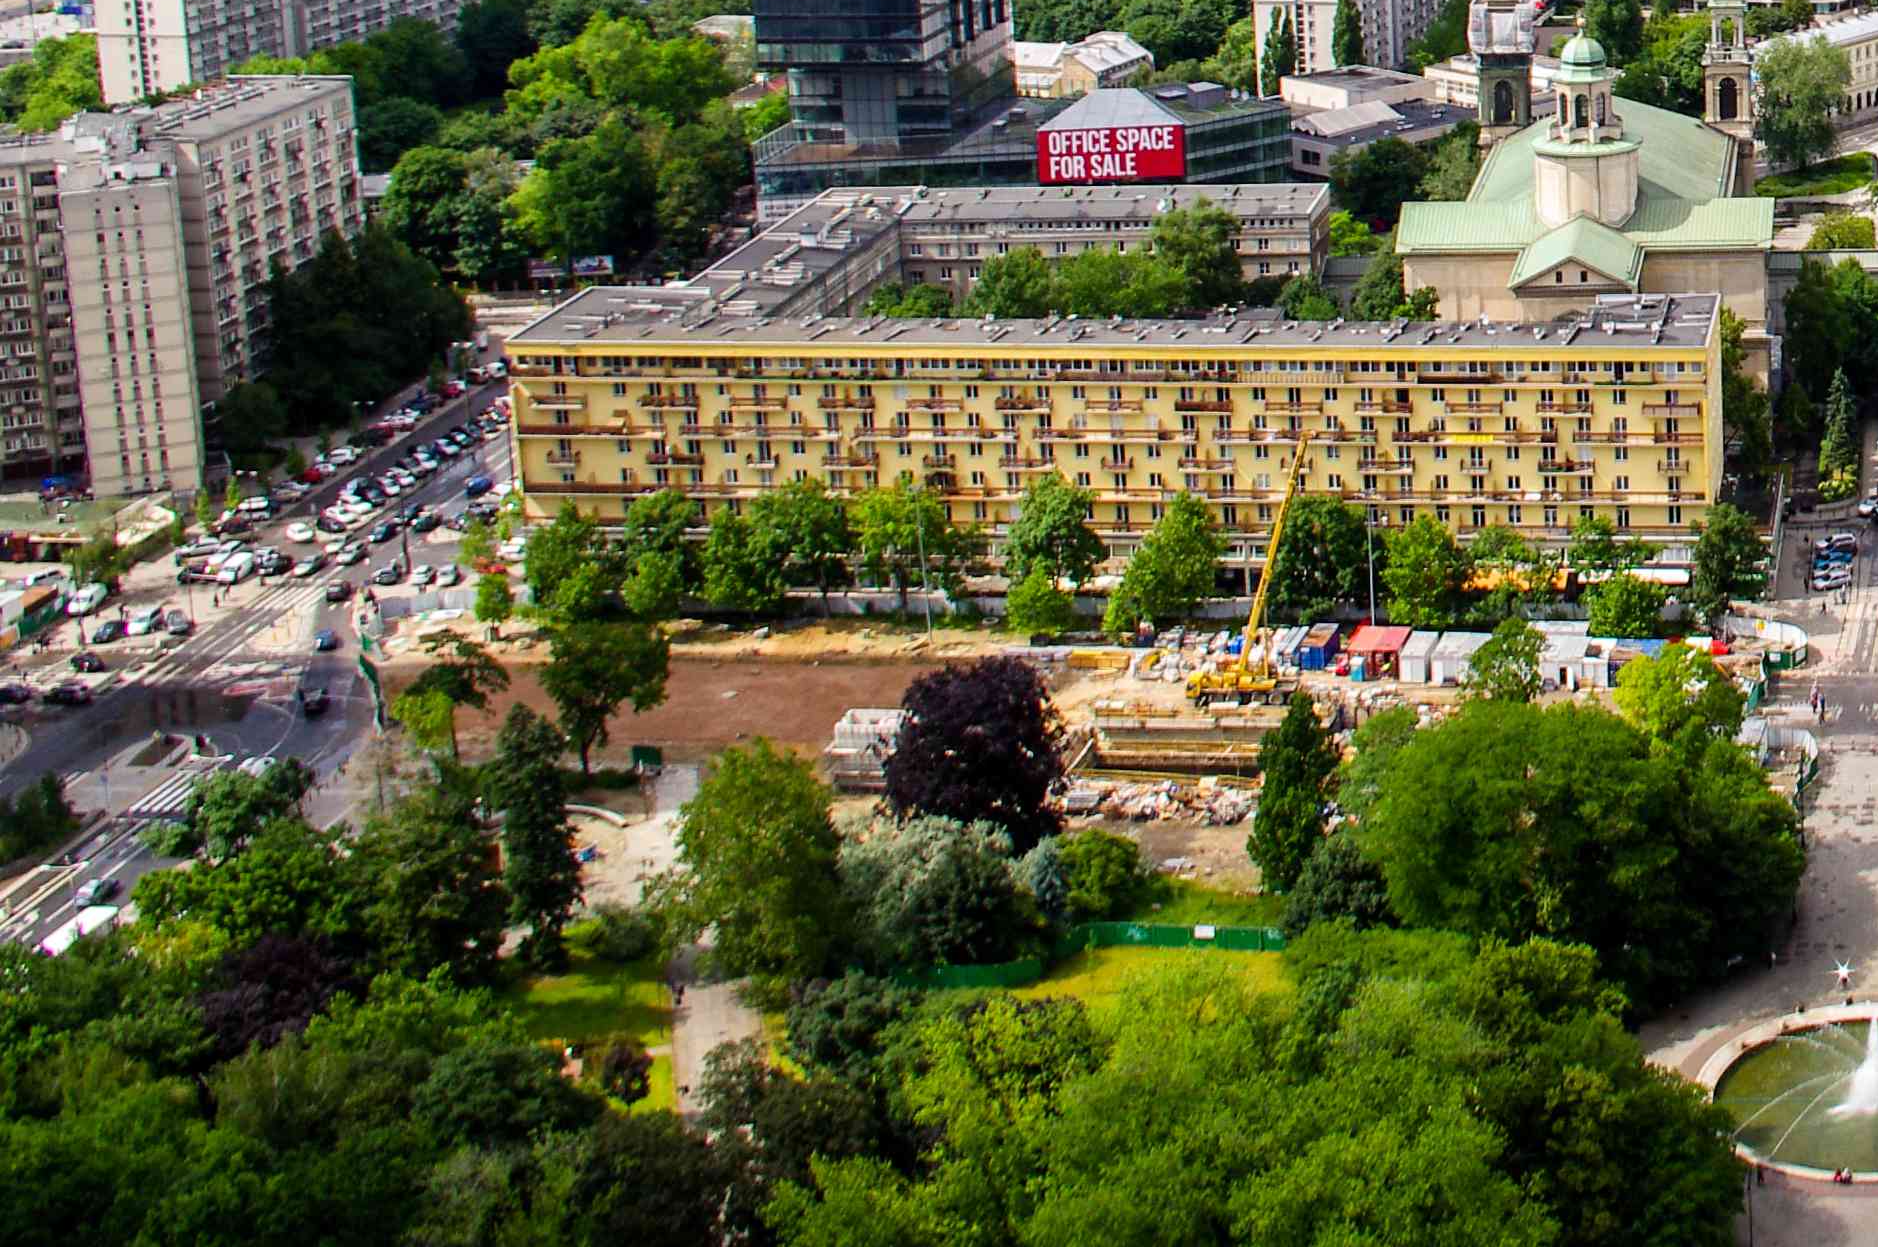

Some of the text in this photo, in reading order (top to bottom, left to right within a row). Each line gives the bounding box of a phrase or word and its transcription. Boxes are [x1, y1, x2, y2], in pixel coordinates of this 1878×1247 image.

[1048, 127, 1175, 155] OFFICE SPACE
[1049, 153, 1137, 180] FOR SALE
